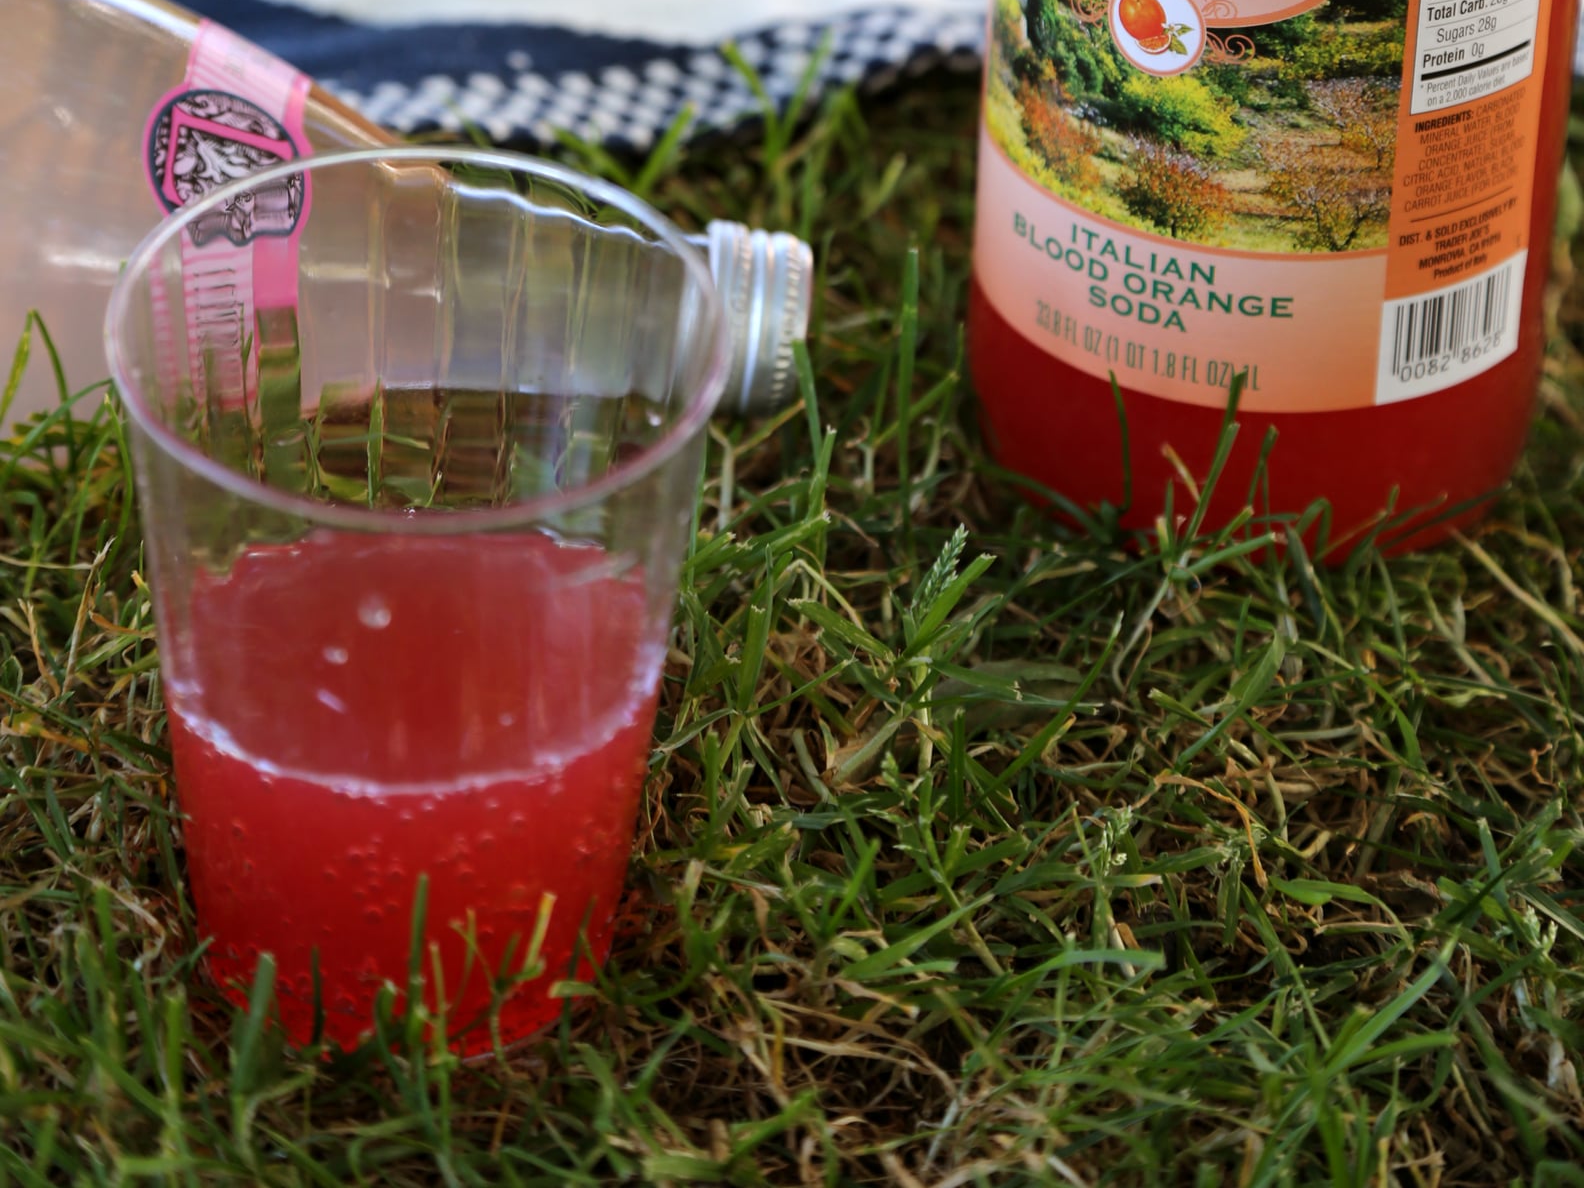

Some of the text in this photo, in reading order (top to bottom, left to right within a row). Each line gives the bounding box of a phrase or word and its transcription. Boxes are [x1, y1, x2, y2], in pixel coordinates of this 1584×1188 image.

[1427, 3, 1456, 21] Total
[1436, 15, 1497, 43] Sugars 28g
[1423, 41, 1485, 68] Protein 0g
[1427, 77, 1456, 93] Percent
[1458, 72, 1476, 87] Daily
[1477, 65, 1499, 81] Values
[1427, 96, 1438, 107] on
[1414, 109, 1474, 133] INGREDIENTS:
[1419, 127, 1459, 145] MINERAL
[1424, 139, 1463, 157] ORANGE
[1464, 131, 1488, 147] JUICE
[1403, 171, 1435, 187] CITRIC
[1463, 152, 1498, 173] NATURAL
[1404, 195, 1442, 213] CARROT
[1444, 187, 1468, 204] JUICE
[1415, 180, 1454, 197] ORANGE
[1399, 232, 1423, 247] DIST.
[1425, 230, 1432, 241] &
[1435, 222, 1458, 239] SOLD
[1435, 233, 1468, 253] TRADER
[1070, 222, 1216, 286] ITALIAN
[1468, 242, 1480, 254] CA
[1013, 210, 1294, 319] BLOOD ORANGE
[1433, 262, 1464, 280] Product
[1465, 258, 1472, 270] of
[1088, 285, 1188, 333] SODA
[1064, 315, 1078, 346] FL
[1084, 323, 1102, 356] OZ
[1106, 334, 1119, 363] (1
[1126, 340, 1147, 370] QT
[1152, 348, 1176, 379] 1.8
[1182, 354, 1199, 384] FL
[1400, 331, 1501, 383] 0082 8628
